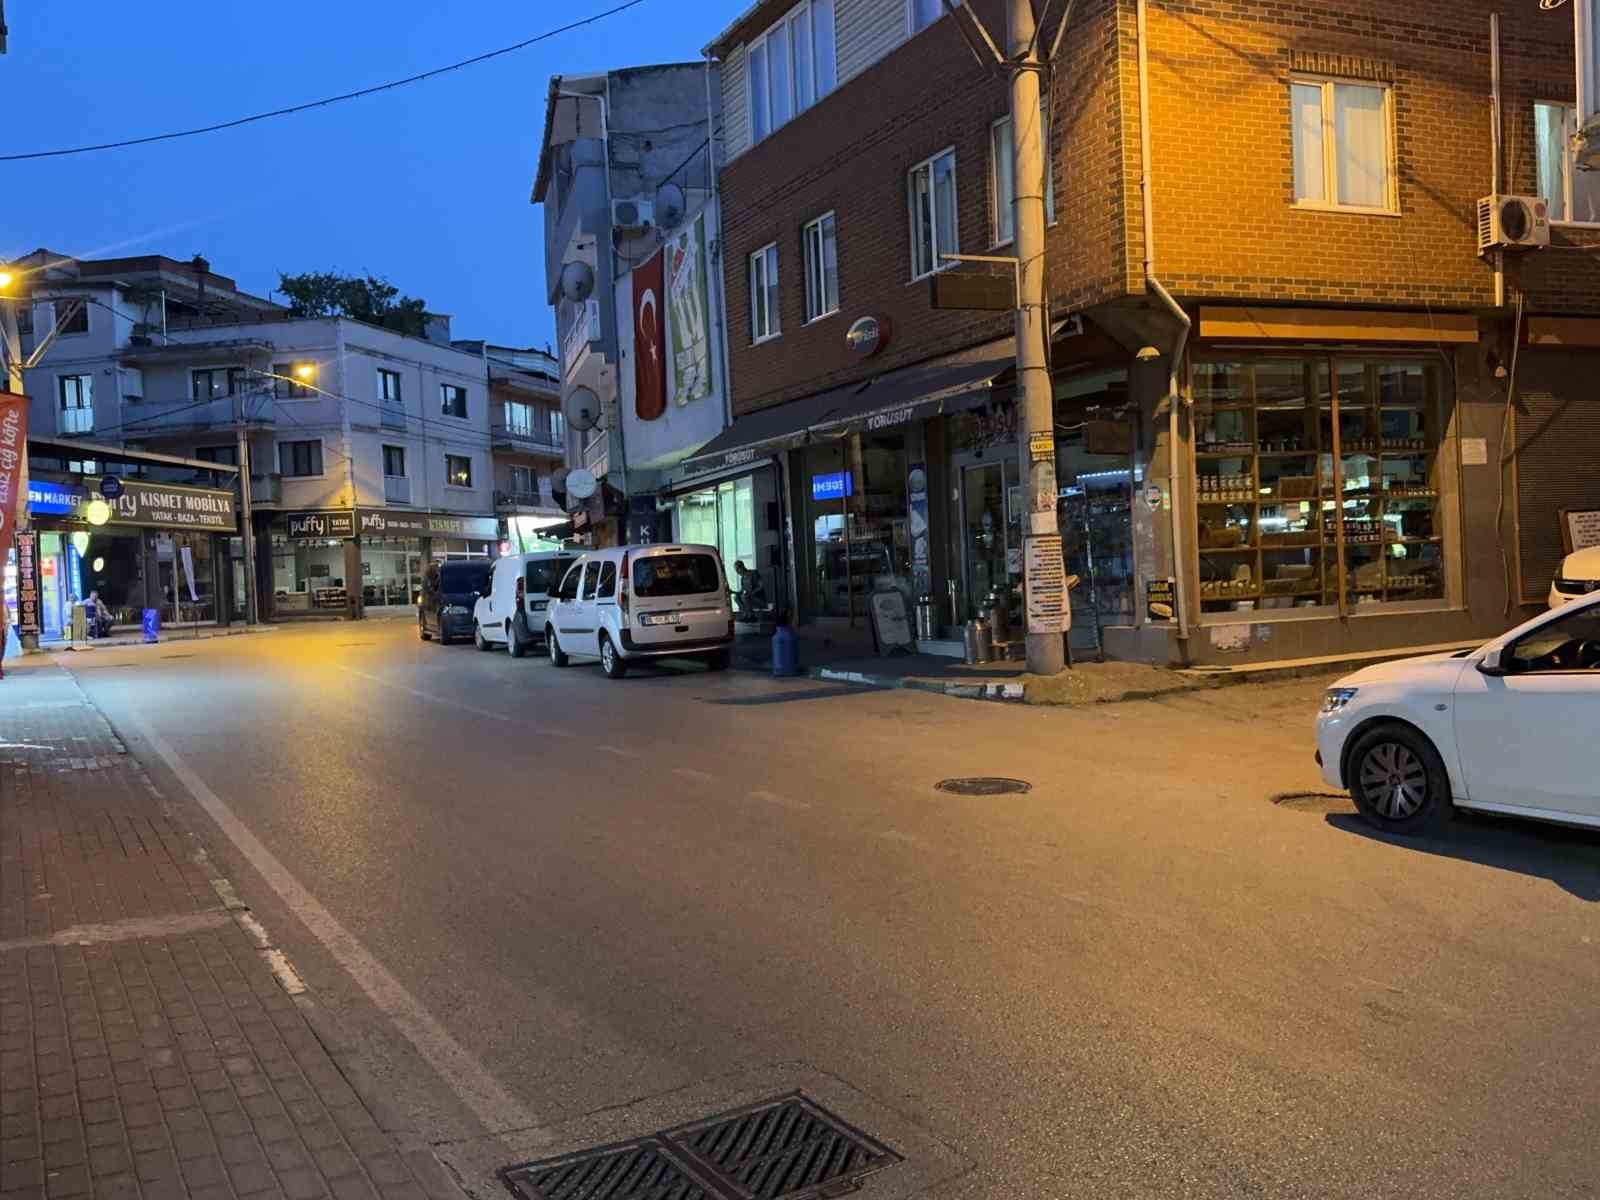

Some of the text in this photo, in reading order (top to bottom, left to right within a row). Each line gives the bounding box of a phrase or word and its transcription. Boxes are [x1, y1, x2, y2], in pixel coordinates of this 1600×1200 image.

[43, 491, 81, 506] MARKET
[139, 491, 231, 513] KISMET MOBİLYA
[151, 511, 174, 521] YATAK
[178, 513, 195, 523] BAZA
[361, 513, 385, 530] puffy
[290, 515, 324, 537] puffy
